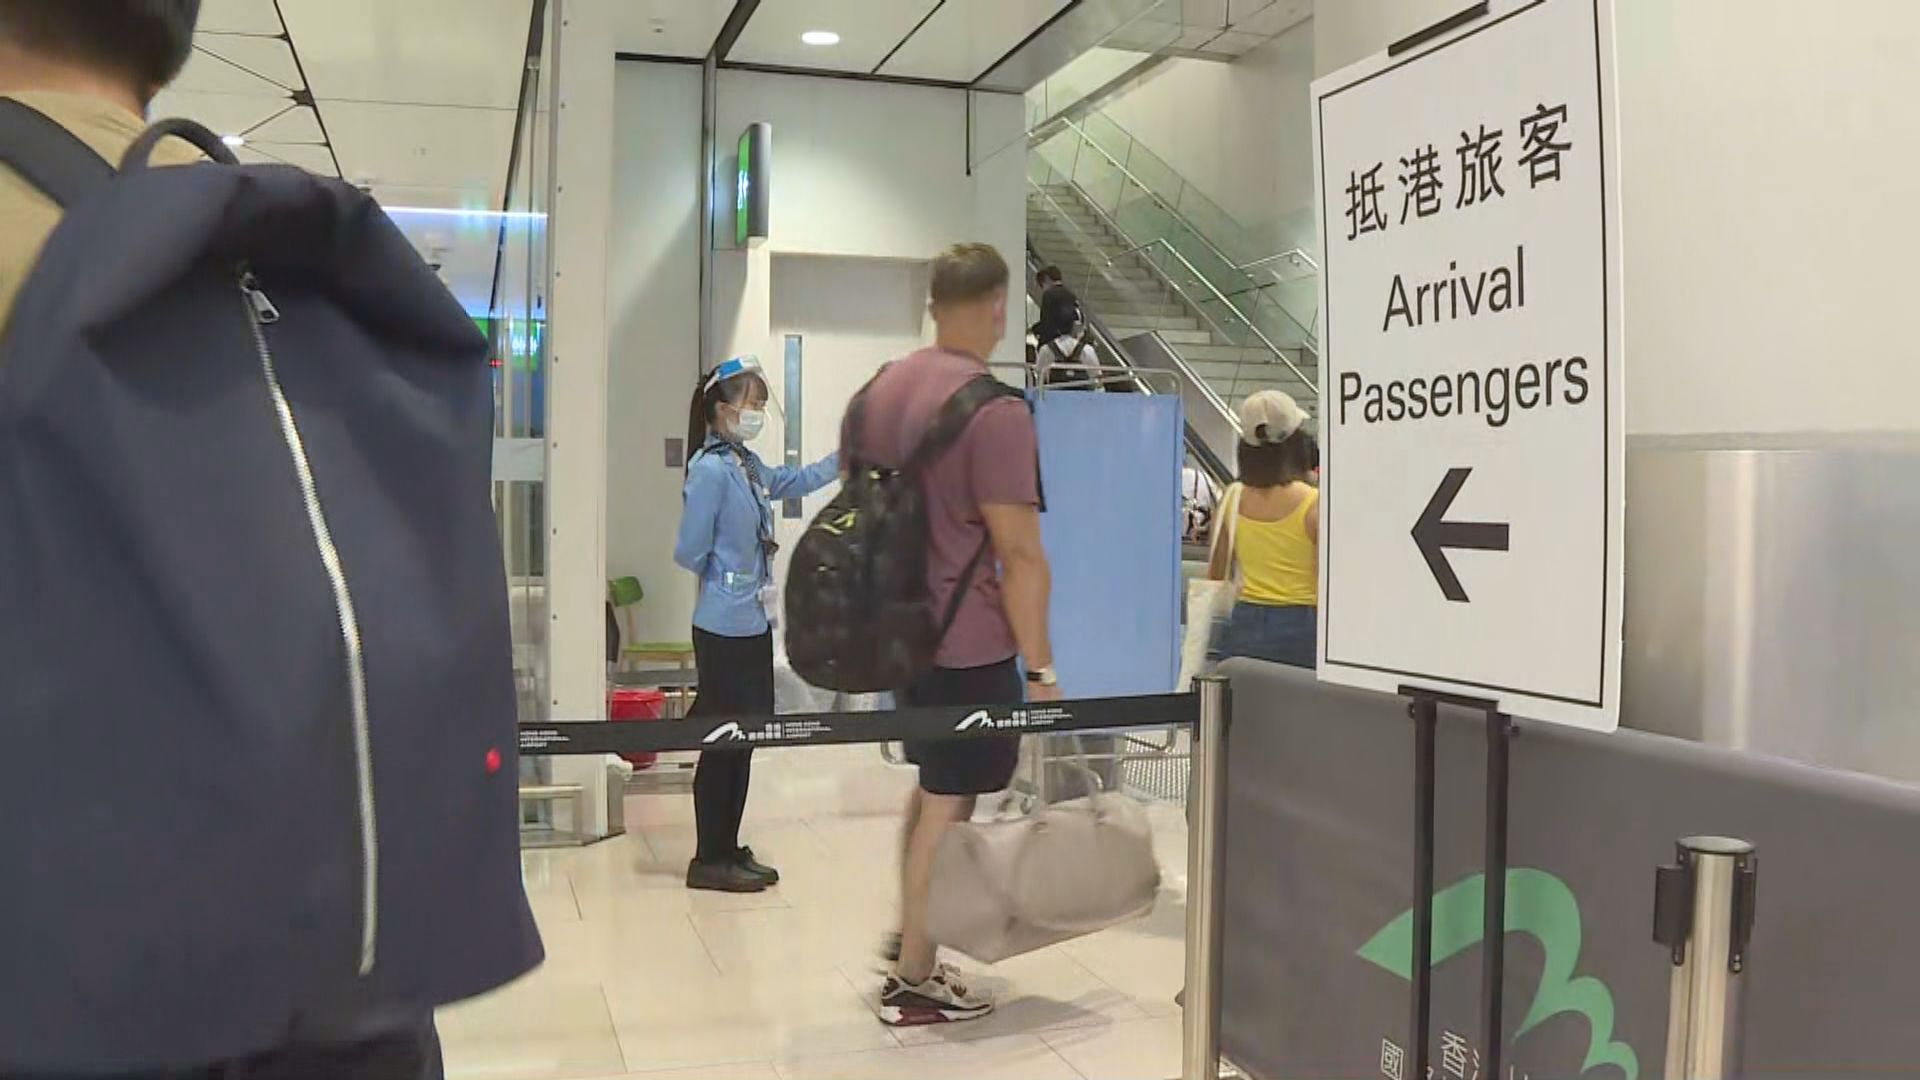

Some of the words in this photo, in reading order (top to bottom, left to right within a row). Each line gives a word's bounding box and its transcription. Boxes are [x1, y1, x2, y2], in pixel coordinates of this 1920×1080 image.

[1345, 103, 1572, 241] 抵港旅客
[1383, 245, 1525, 332] Arrival
[1340, 355, 1589, 427] Passengers
